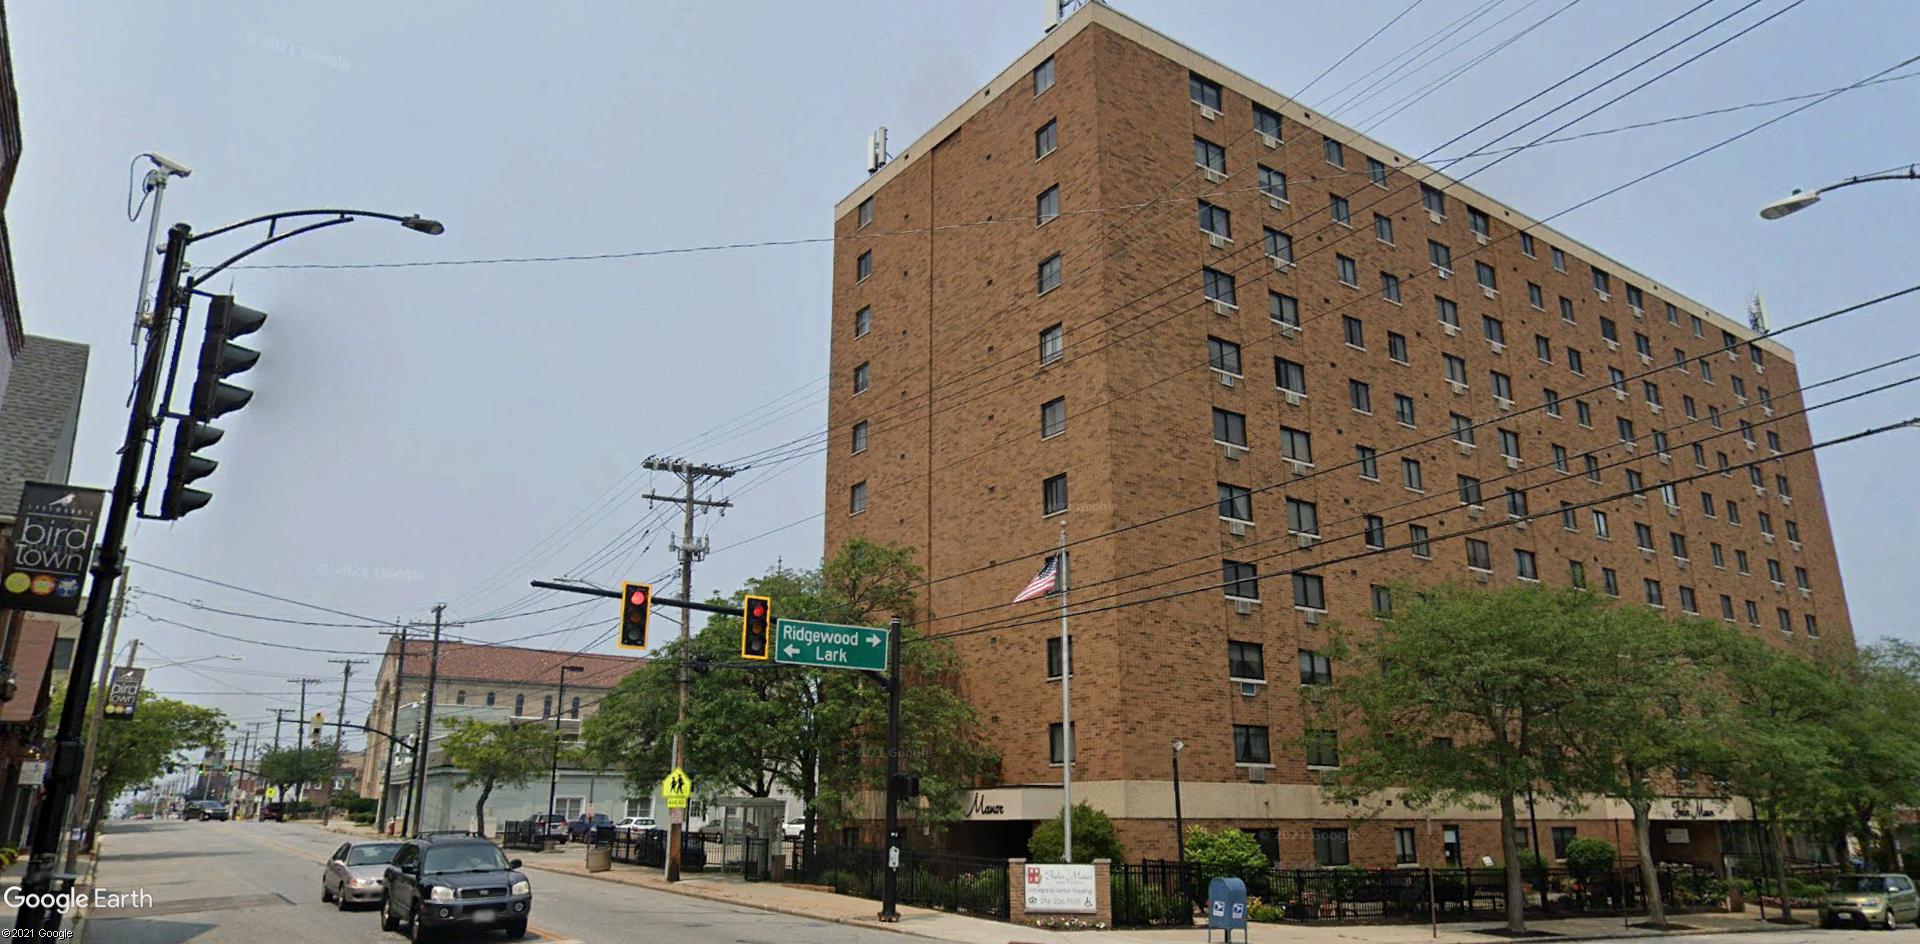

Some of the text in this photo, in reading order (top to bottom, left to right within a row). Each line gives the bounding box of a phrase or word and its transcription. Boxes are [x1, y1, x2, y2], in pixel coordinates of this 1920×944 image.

[21, 517, 91, 549] bird
[16, 543, 83, 571] town
[783, 624, 858, 646] Ridgewood
[815, 646, 848, 662] Lark
[965, 792, 1005, 818] Manor
